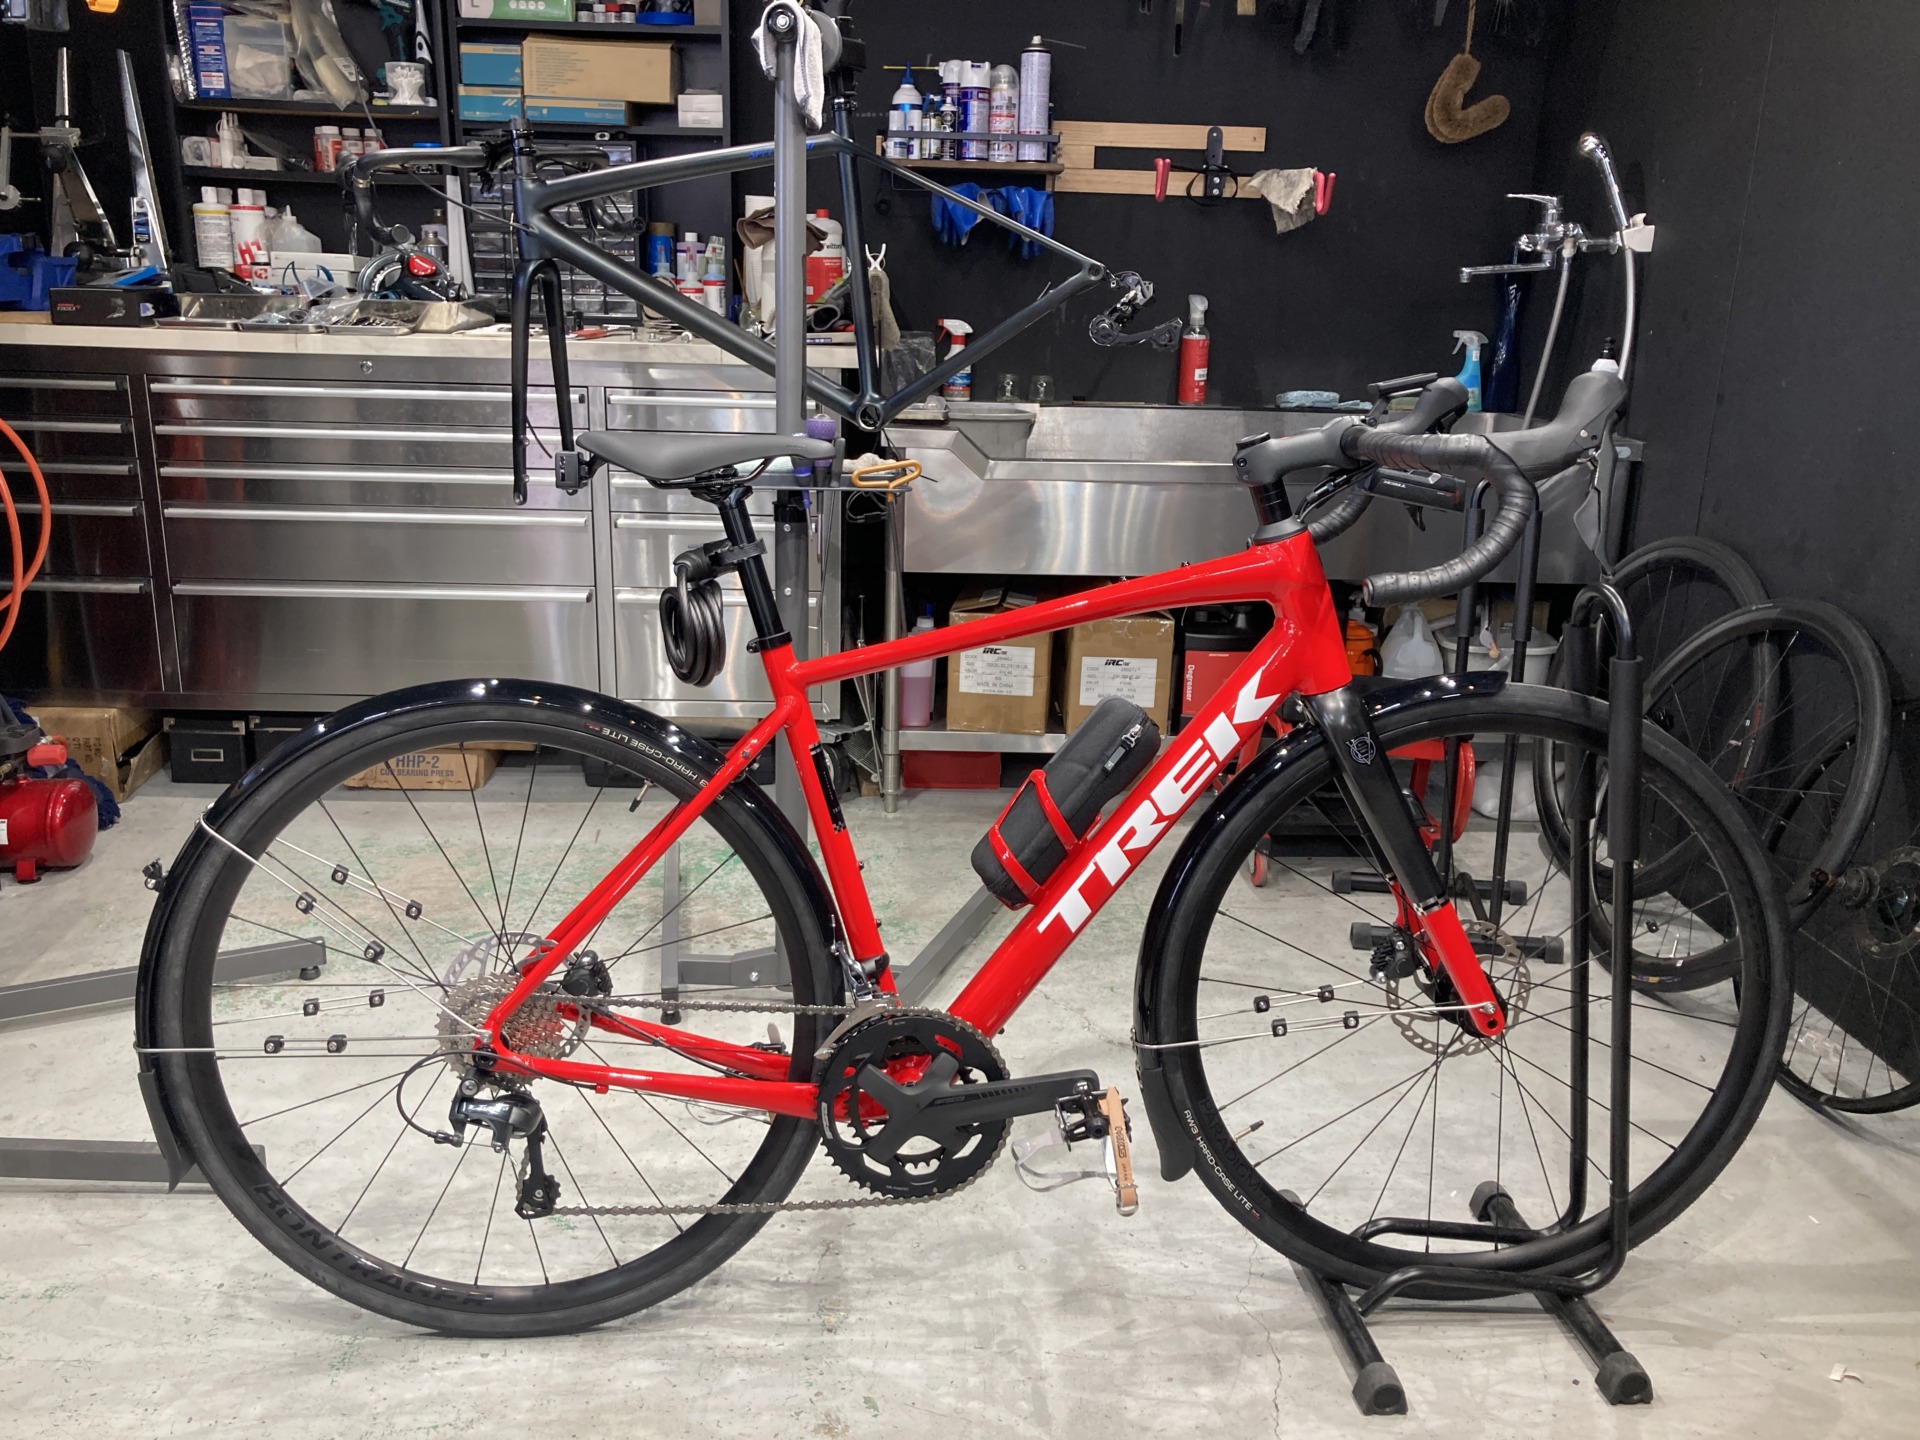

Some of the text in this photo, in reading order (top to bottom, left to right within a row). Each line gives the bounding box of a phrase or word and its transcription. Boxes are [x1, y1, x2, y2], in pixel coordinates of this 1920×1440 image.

[1186, 664, 1196, 702] Degreaser
[601, 727, 629, 742] LITE
[396, 755, 440, 769] HHP-2
[396, 769, 429, 777] BEARING
[430, 769, 455, 777] PRESS
[630, 738, 698, 781] HARD-CASE
[1037, 667, 1281, 933] TREK
[1115, 1126, 1127, 1158] MKS
[1184, 1109, 1253, 1211] AW3 HARD-CASE LITE
[253, 1183, 495, 1306] BONTRAGER
